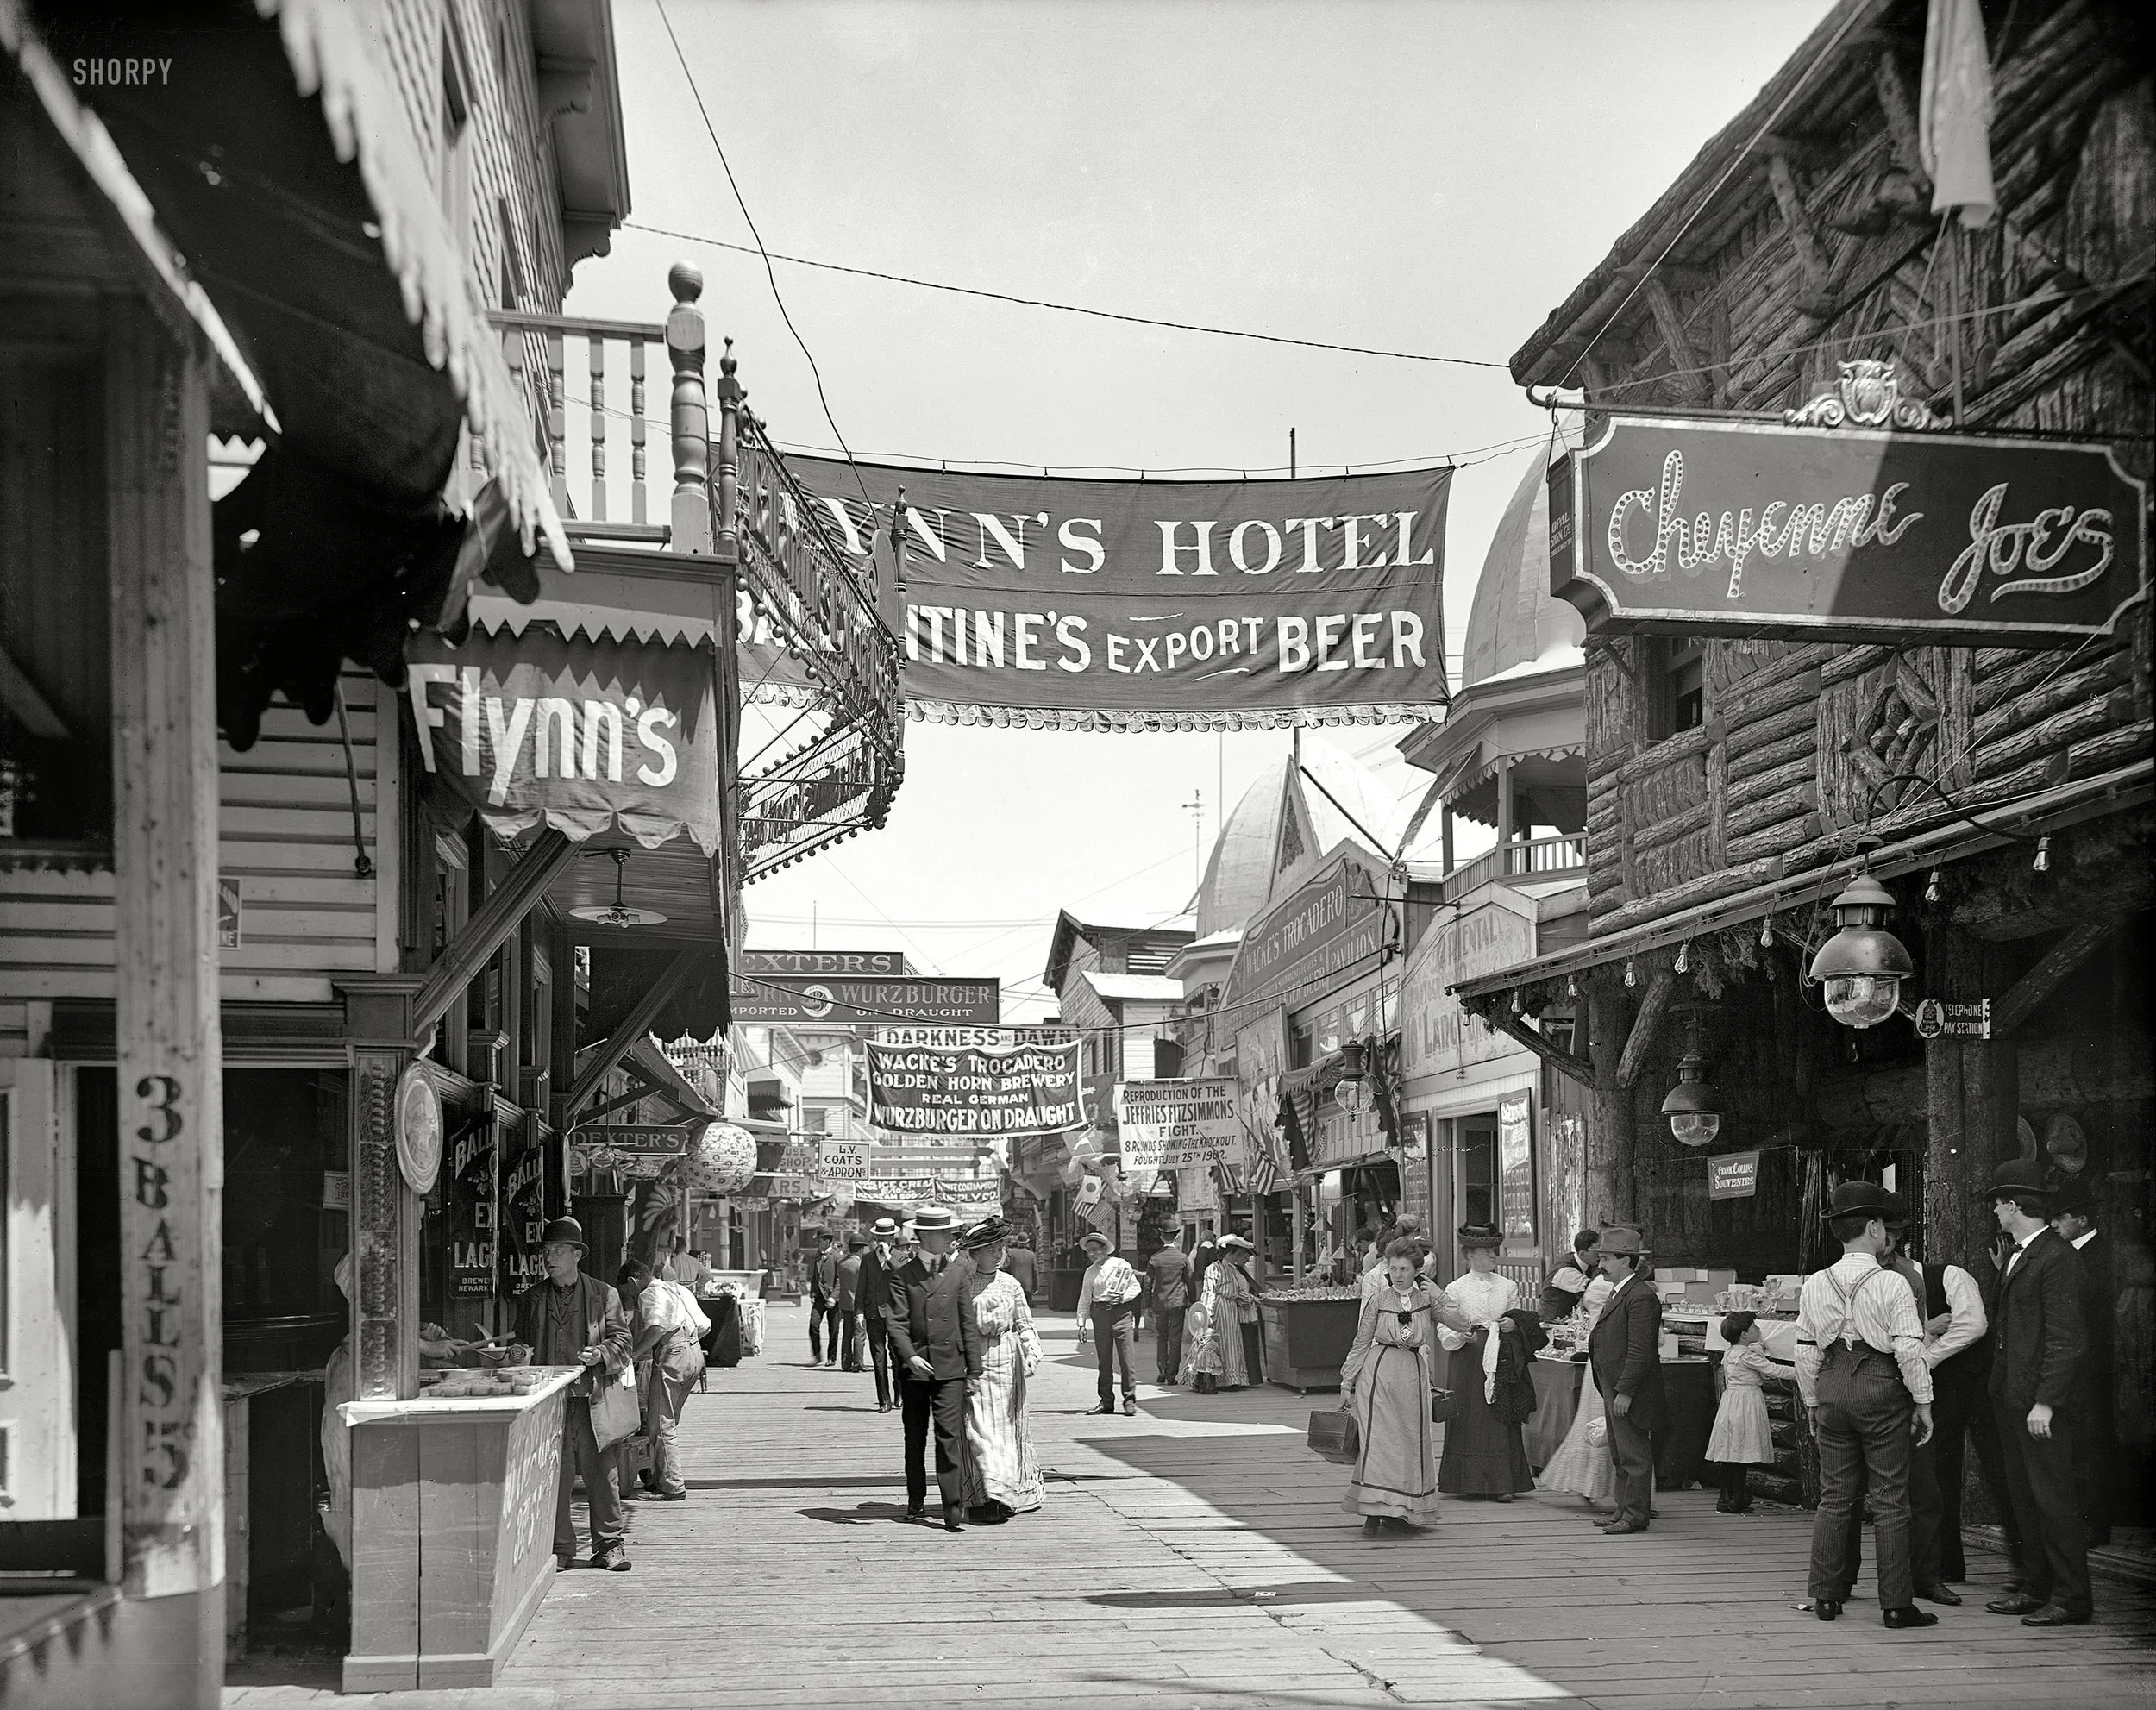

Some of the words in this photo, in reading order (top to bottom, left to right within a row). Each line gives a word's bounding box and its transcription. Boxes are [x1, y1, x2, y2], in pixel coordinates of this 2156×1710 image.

[1551, 511, 1570, 533] OPAL
[1608, 450, 1924, 598] Cheyenne
[1156, 510, 1434, 576] HOTEL
[1108, 617, 1264, 673] EXPORT
[1279, 611, 1426, 673] BEER
[408, 663, 678, 807] Flynn's
[1282, 885, 1343, 953] TROCADERO
[1331, 930, 1377, 973] PAVILION
[741, 954, 892, 973] EXTERS
[1303, 967, 1326, 997] BEER
[841, 984, 991, 1005] WURZBURGER
[1945, 1004, 1982, 1017] TELEPHONE
[887, 1029, 1000, 1046] DARKNESS
[1944, 1022, 1956, 1034] PAY
[1957, 1022, 1983, 1035] STATION
[877, 1053, 957, 1073] WACKE'S
[968, 1054, 1066, 1074] TROCADERO
[872, 1071, 938, 1090] GOLDEN
[948, 1076, 992, 1092] HORN
[1001, 1070, 1076, 1092] BREWERY
[922, 1093, 962, 1105] REAL
[968, 1093, 1028, 1105] GERMAN
[1123, 1087, 1188, 1105] REPRODUCTION
[1191, 1087, 1202, 1099] OF
[1206, 1086, 1225, 1098] THE
[136, 1075, 183, 1143] 3
[874, 1104, 977, 1131] WURZBURGER
[981, 1109, 1002, 1131] ON
[1005, 1101, 1075, 1130] DRAUGHT
[1123, 1105, 1167, 1125] JEFFRIES
[1169, 1099, 1234, 1124] FITZSIMMONS
[572, 1131, 680, 1148] DEXTER'S
[1159, 1124, 1199, 1137] FIGHT.
[1125, 1140, 1131, 1152] 8
[1131, 1140, 1156, 1152] ROUNDS
[1157, 1138, 1188, 1150] SHOWING
[1188, 1137, 1199, 1149] THE
[824, 1156, 862, 1165] COATS
[1133, 1155, 1163, 1165] FOUGHT
[1163, 1154, 1180, 1164] JULY
[1182, 1152, 1200, 1162] 25TH
[746, 1180, 805, 1195] GARS.
[1715, 1175, 1754, 1189] SOUVENIRS
[132, 1156, 178, 1409] BALLS
